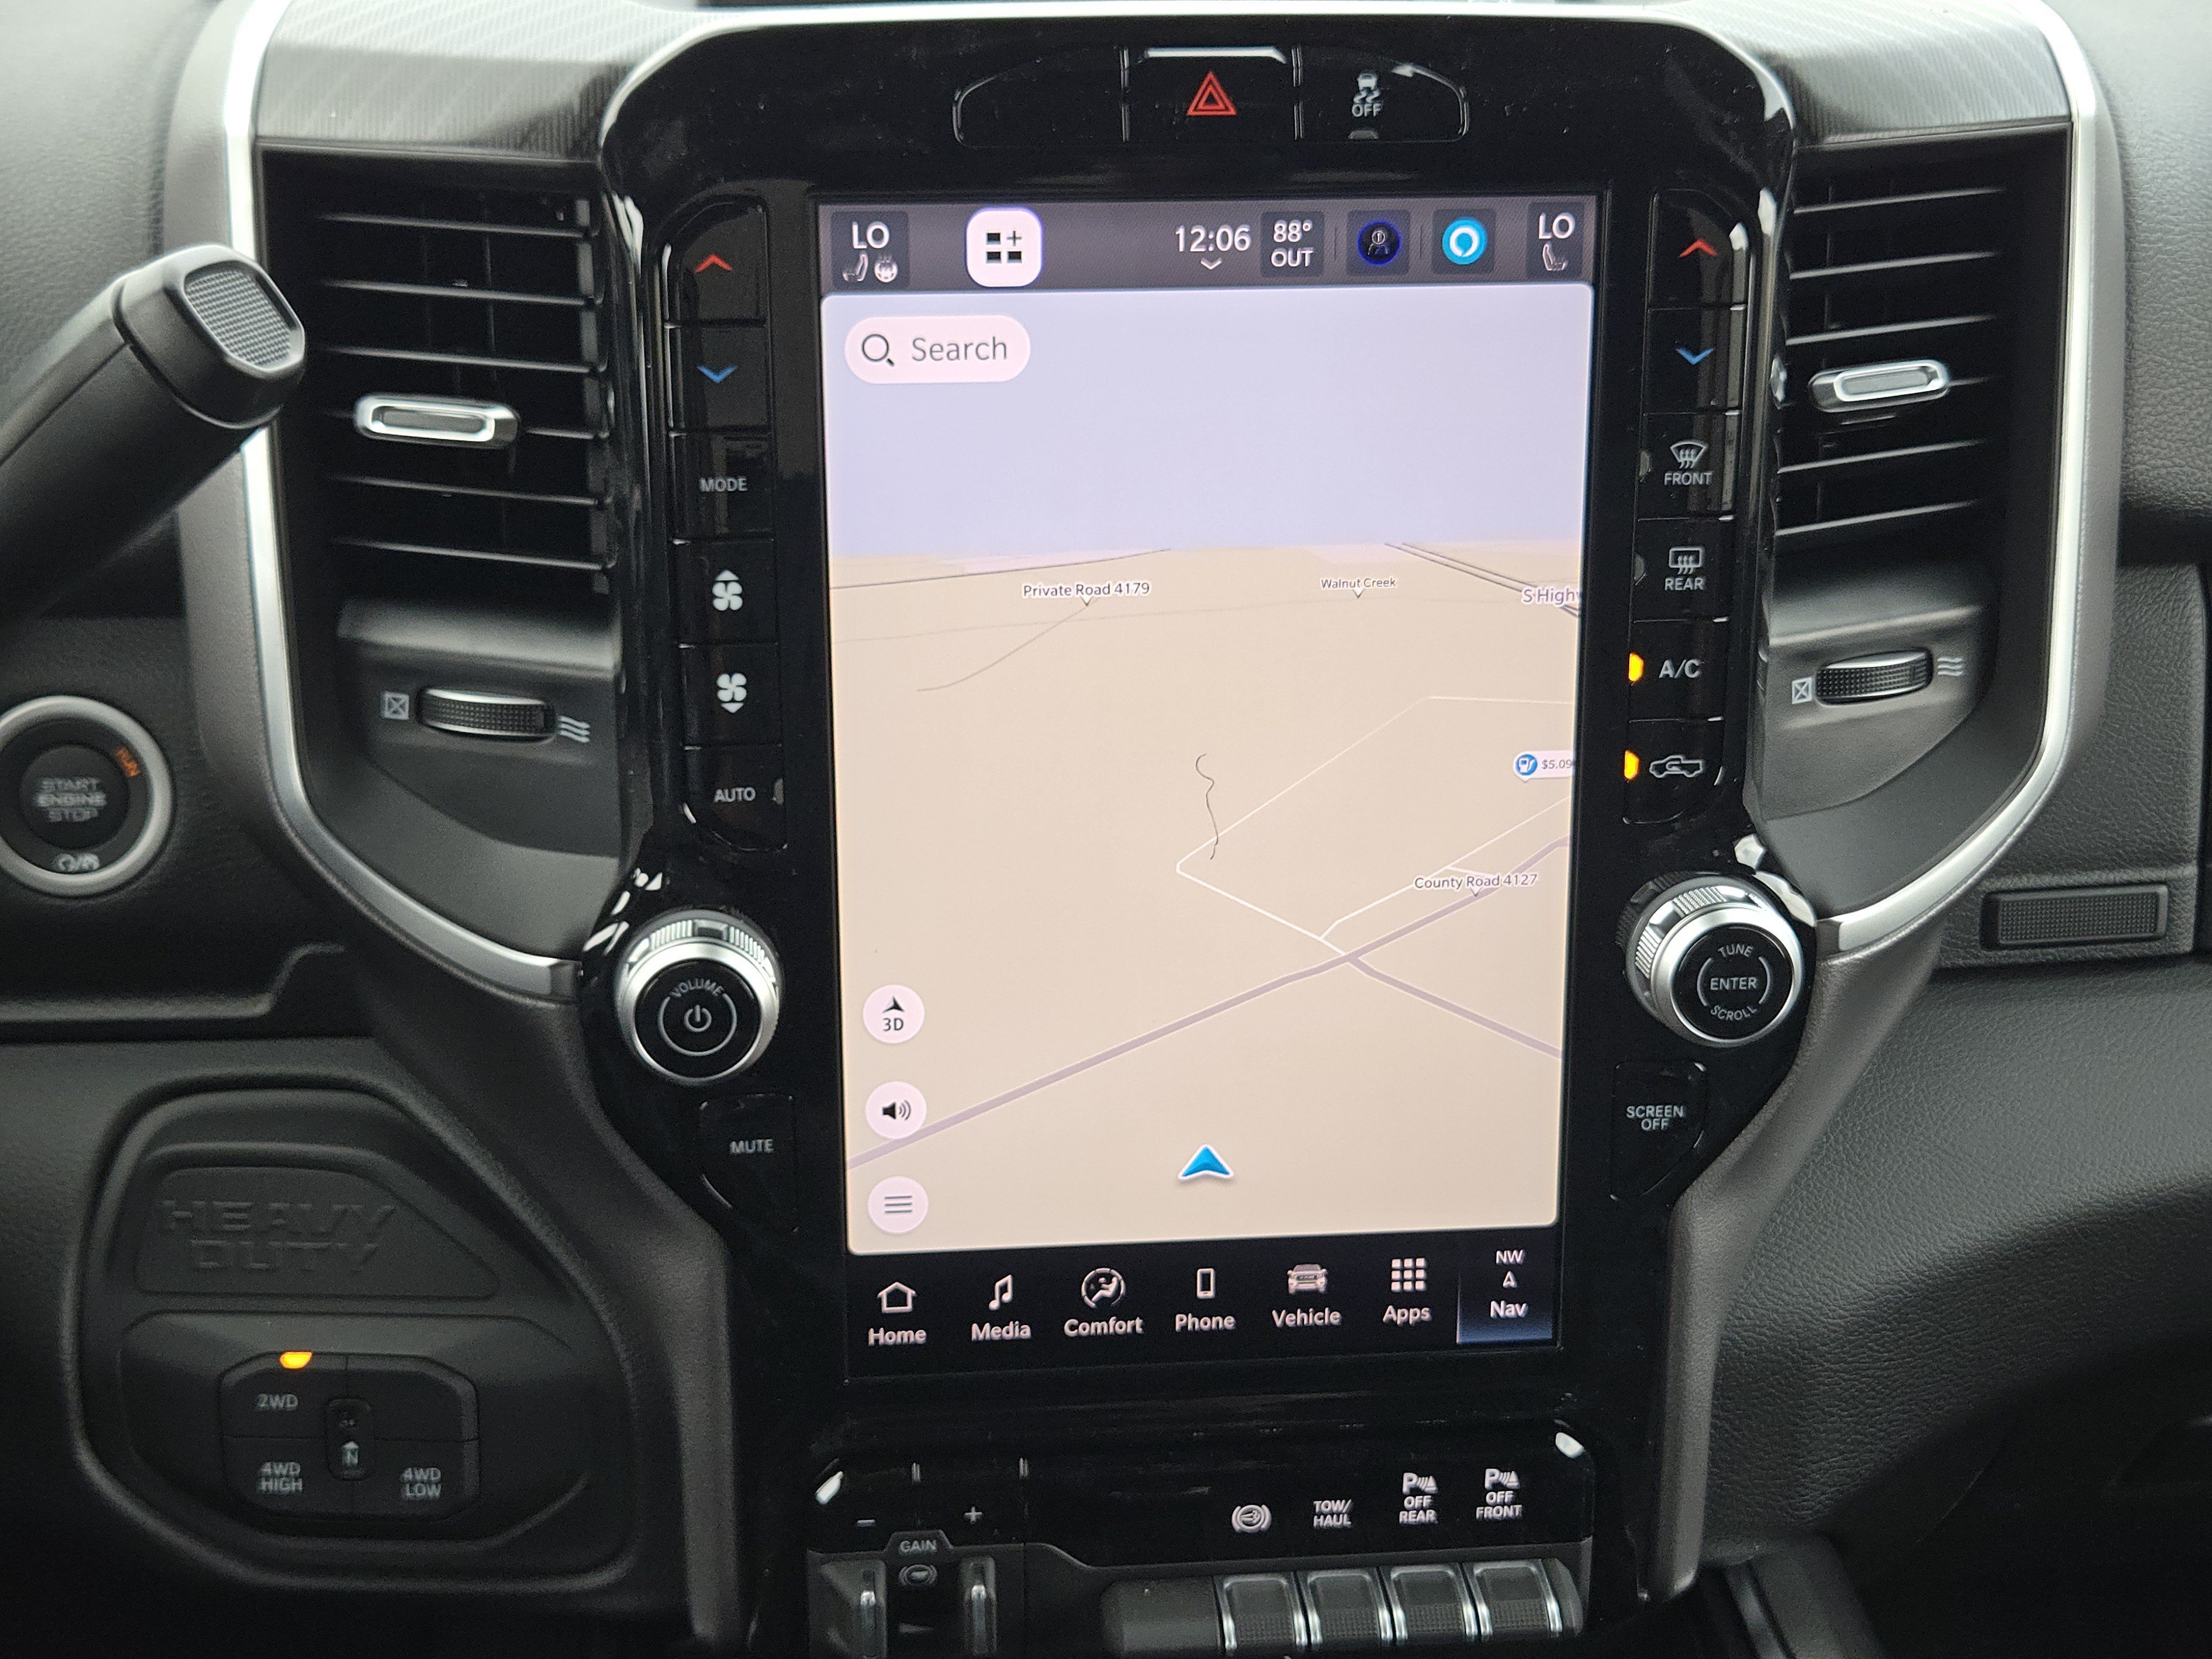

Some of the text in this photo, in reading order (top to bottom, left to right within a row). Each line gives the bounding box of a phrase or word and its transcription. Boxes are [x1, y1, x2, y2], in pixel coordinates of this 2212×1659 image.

[1352, 103, 1382, 117] OFF
[1273, 220, 1313, 243] 88°
[1538, 212, 1575, 239] LO
[852, 221, 890, 249] LO
[1175, 225, 1251, 252] 12:06
[1271, 247, 1314, 267] OUT
[911, 336, 1008, 362] Search
[699, 476, 747, 492] MODE
[1663, 471, 1713, 486] FRONT
[1023, 582, 1150, 597] Private Road 4179
[1321, 577, 1396, 589] Walnut Creek
[1664, 576, 1706, 591] REAR
[1523, 588, 1579, 605] S High
[1659, 659, 1702, 679] A/C
[41, 776, 101, 792] START
[35, 791, 107, 807] ENGINE
[713, 786, 756, 802] AUTO
[47, 807, 100, 822] STOP
[1415, 874, 1537, 890] County Road 4127
[1718, 943, 1754, 958] TUNE
[669, 978, 725, 997] VOLUME
[1710, 977, 1757, 990] ENTER
[1710, 1004, 1757, 1021] SCROLL
[883, 1018, 904, 1031] 3D
[1626, 1105, 1686, 1119] SCREEN
[1640, 1118, 1670, 1131] OFF
[729, 1139, 774, 1155] MUTE
[160, 1199, 396, 1237] HEAVY
[190, 1239, 379, 1273] DUTY
[1495, 1249, 1525, 1265] NW
[1271, 1307, 1342, 1328] Vehicle
[1382, 1305, 1432, 1326] Apps
[1490, 1300, 1528, 1319] Nav
[1063, 1316, 1144, 1338] Comfort
[1175, 1313, 1237, 1333] Phone
[868, 1327, 927, 1347] Home
[971, 1321, 1032, 1342] Media
[257, 1393, 299, 1411] 2WD
[259, 1461, 301, 1477] 4WD
[400, 1467, 442, 1483] 4WD
[258, 1477, 303, 1493] HIGH
[403, 1483, 442, 1500] LOW
[1404, 1495, 1433, 1511] OFF
[1485, 1490, 1516, 1506] OFF
[1313, 1499, 1353, 1514] TOW/
[1475, 1504, 1523, 1521] FRONT
[1313, 1514, 1352, 1528] HAUL
[1399, 1509, 1438, 1525] REAR
[898, 1540, 939, 1554] GAIN
